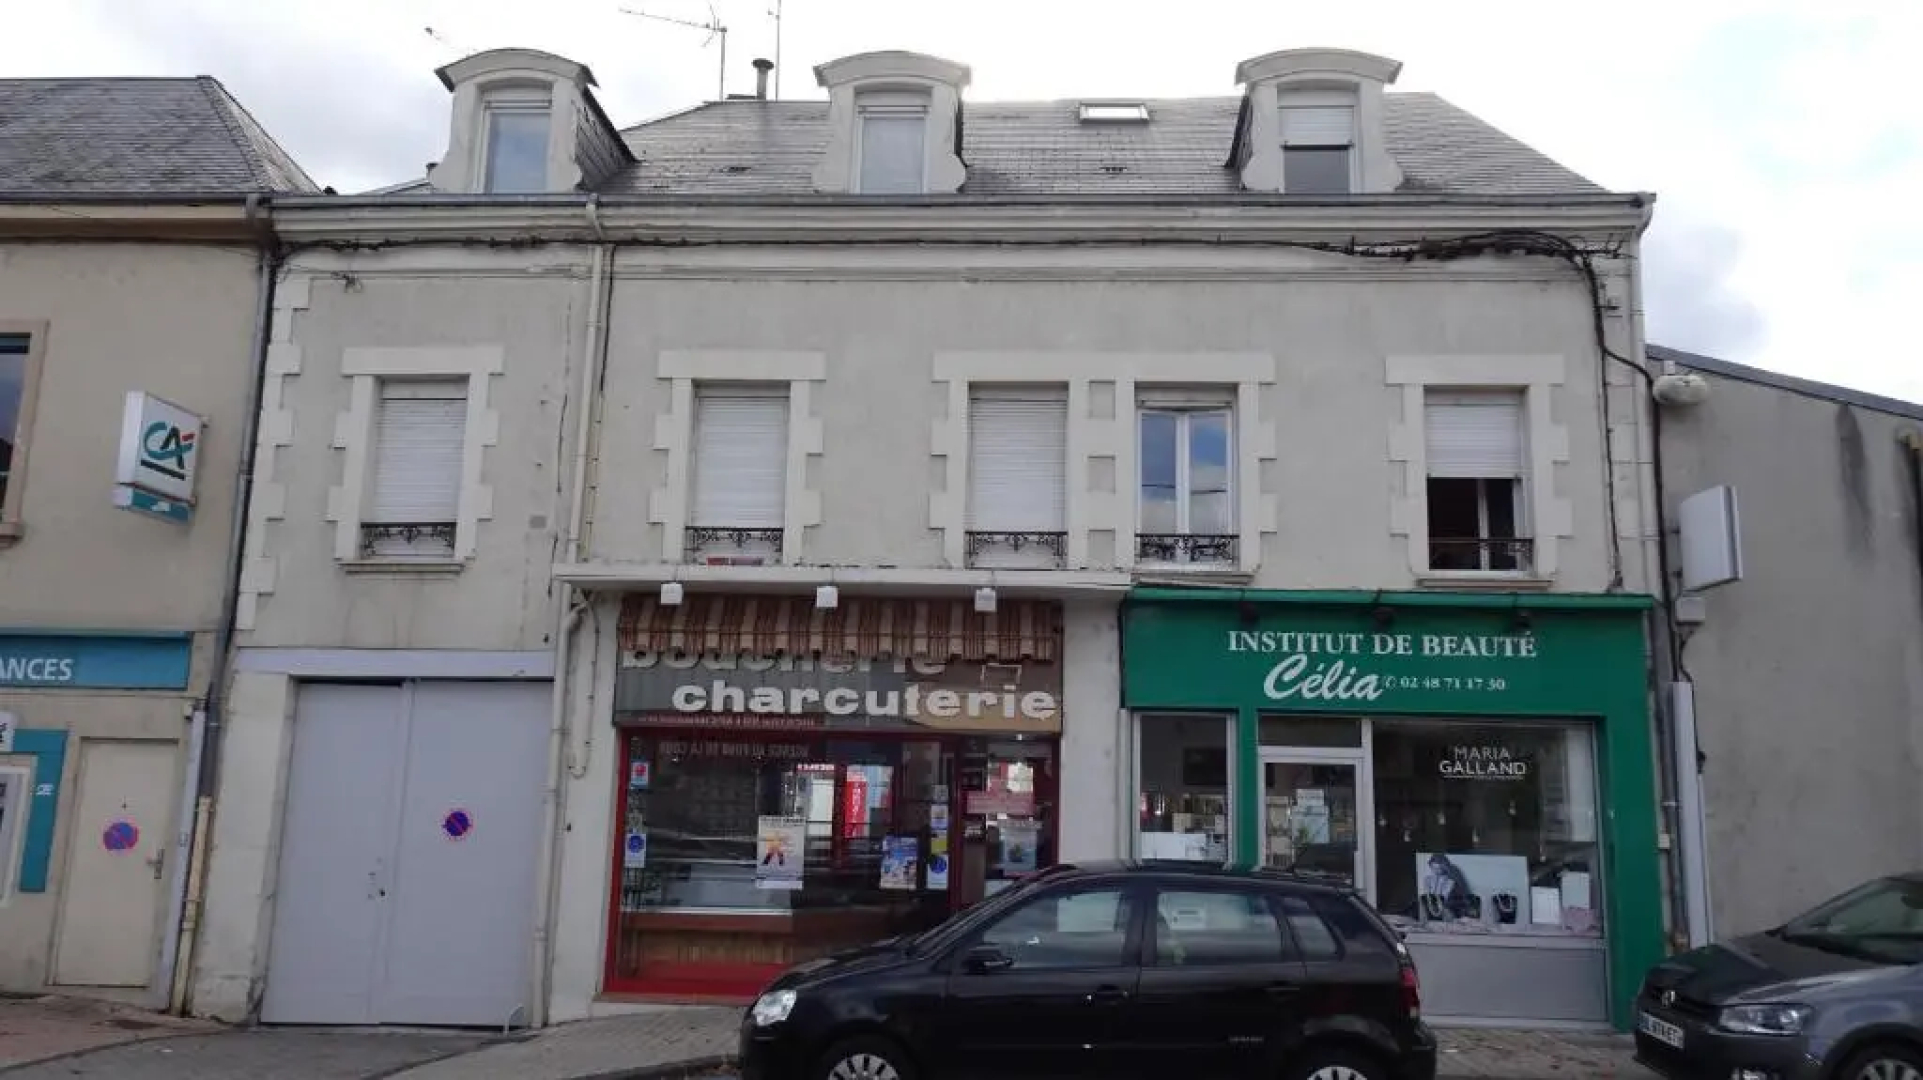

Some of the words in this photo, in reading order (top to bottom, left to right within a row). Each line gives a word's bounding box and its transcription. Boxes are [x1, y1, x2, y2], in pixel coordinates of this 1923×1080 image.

[1227, 630, 1364, 655] INSTITUT
[1370, 634, 1412, 655] DE
[1422, 631, 1537, 657] BEAUTÉ
[1263, 653, 1384, 702] Célia
[1400, 675, 1418, 688] 02
[1422, 675, 1441, 689] 48
[1443, 676, 1460, 689] 71
[671, 679, 1056, 720] charcuterie
[1454, 745, 1511, 760] MARIA
[1439, 760, 1527, 775] GALLAND
